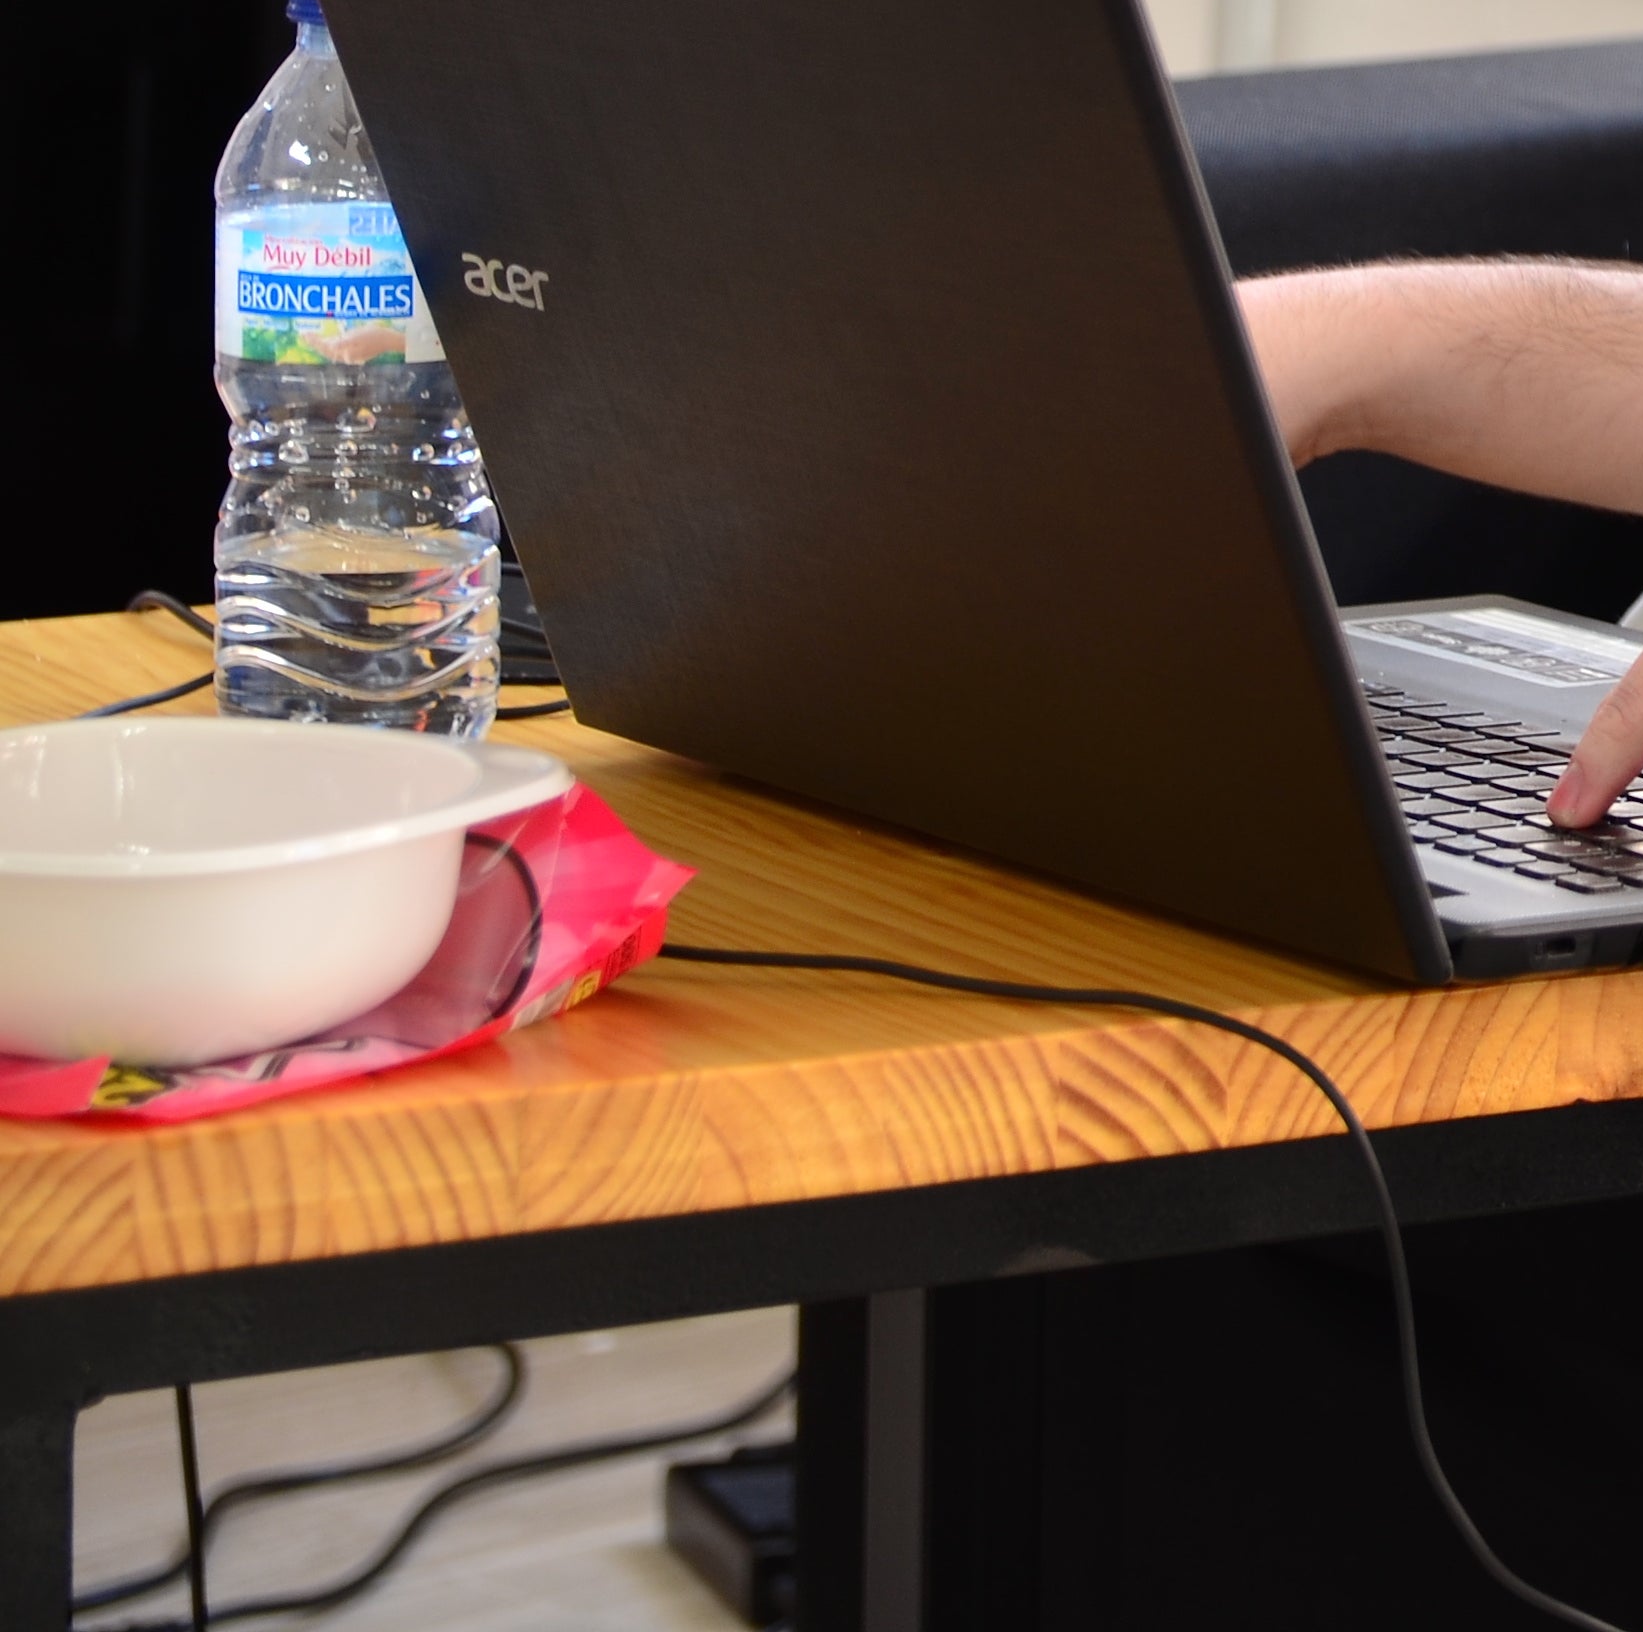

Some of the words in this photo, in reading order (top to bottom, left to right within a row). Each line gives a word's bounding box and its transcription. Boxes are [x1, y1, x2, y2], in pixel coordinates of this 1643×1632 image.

[263, 244, 306, 270] Muy
[315, 245, 371, 267] Débil
[239, 279, 411, 314] BRONCHALES
[461, 252, 549, 311] acer
